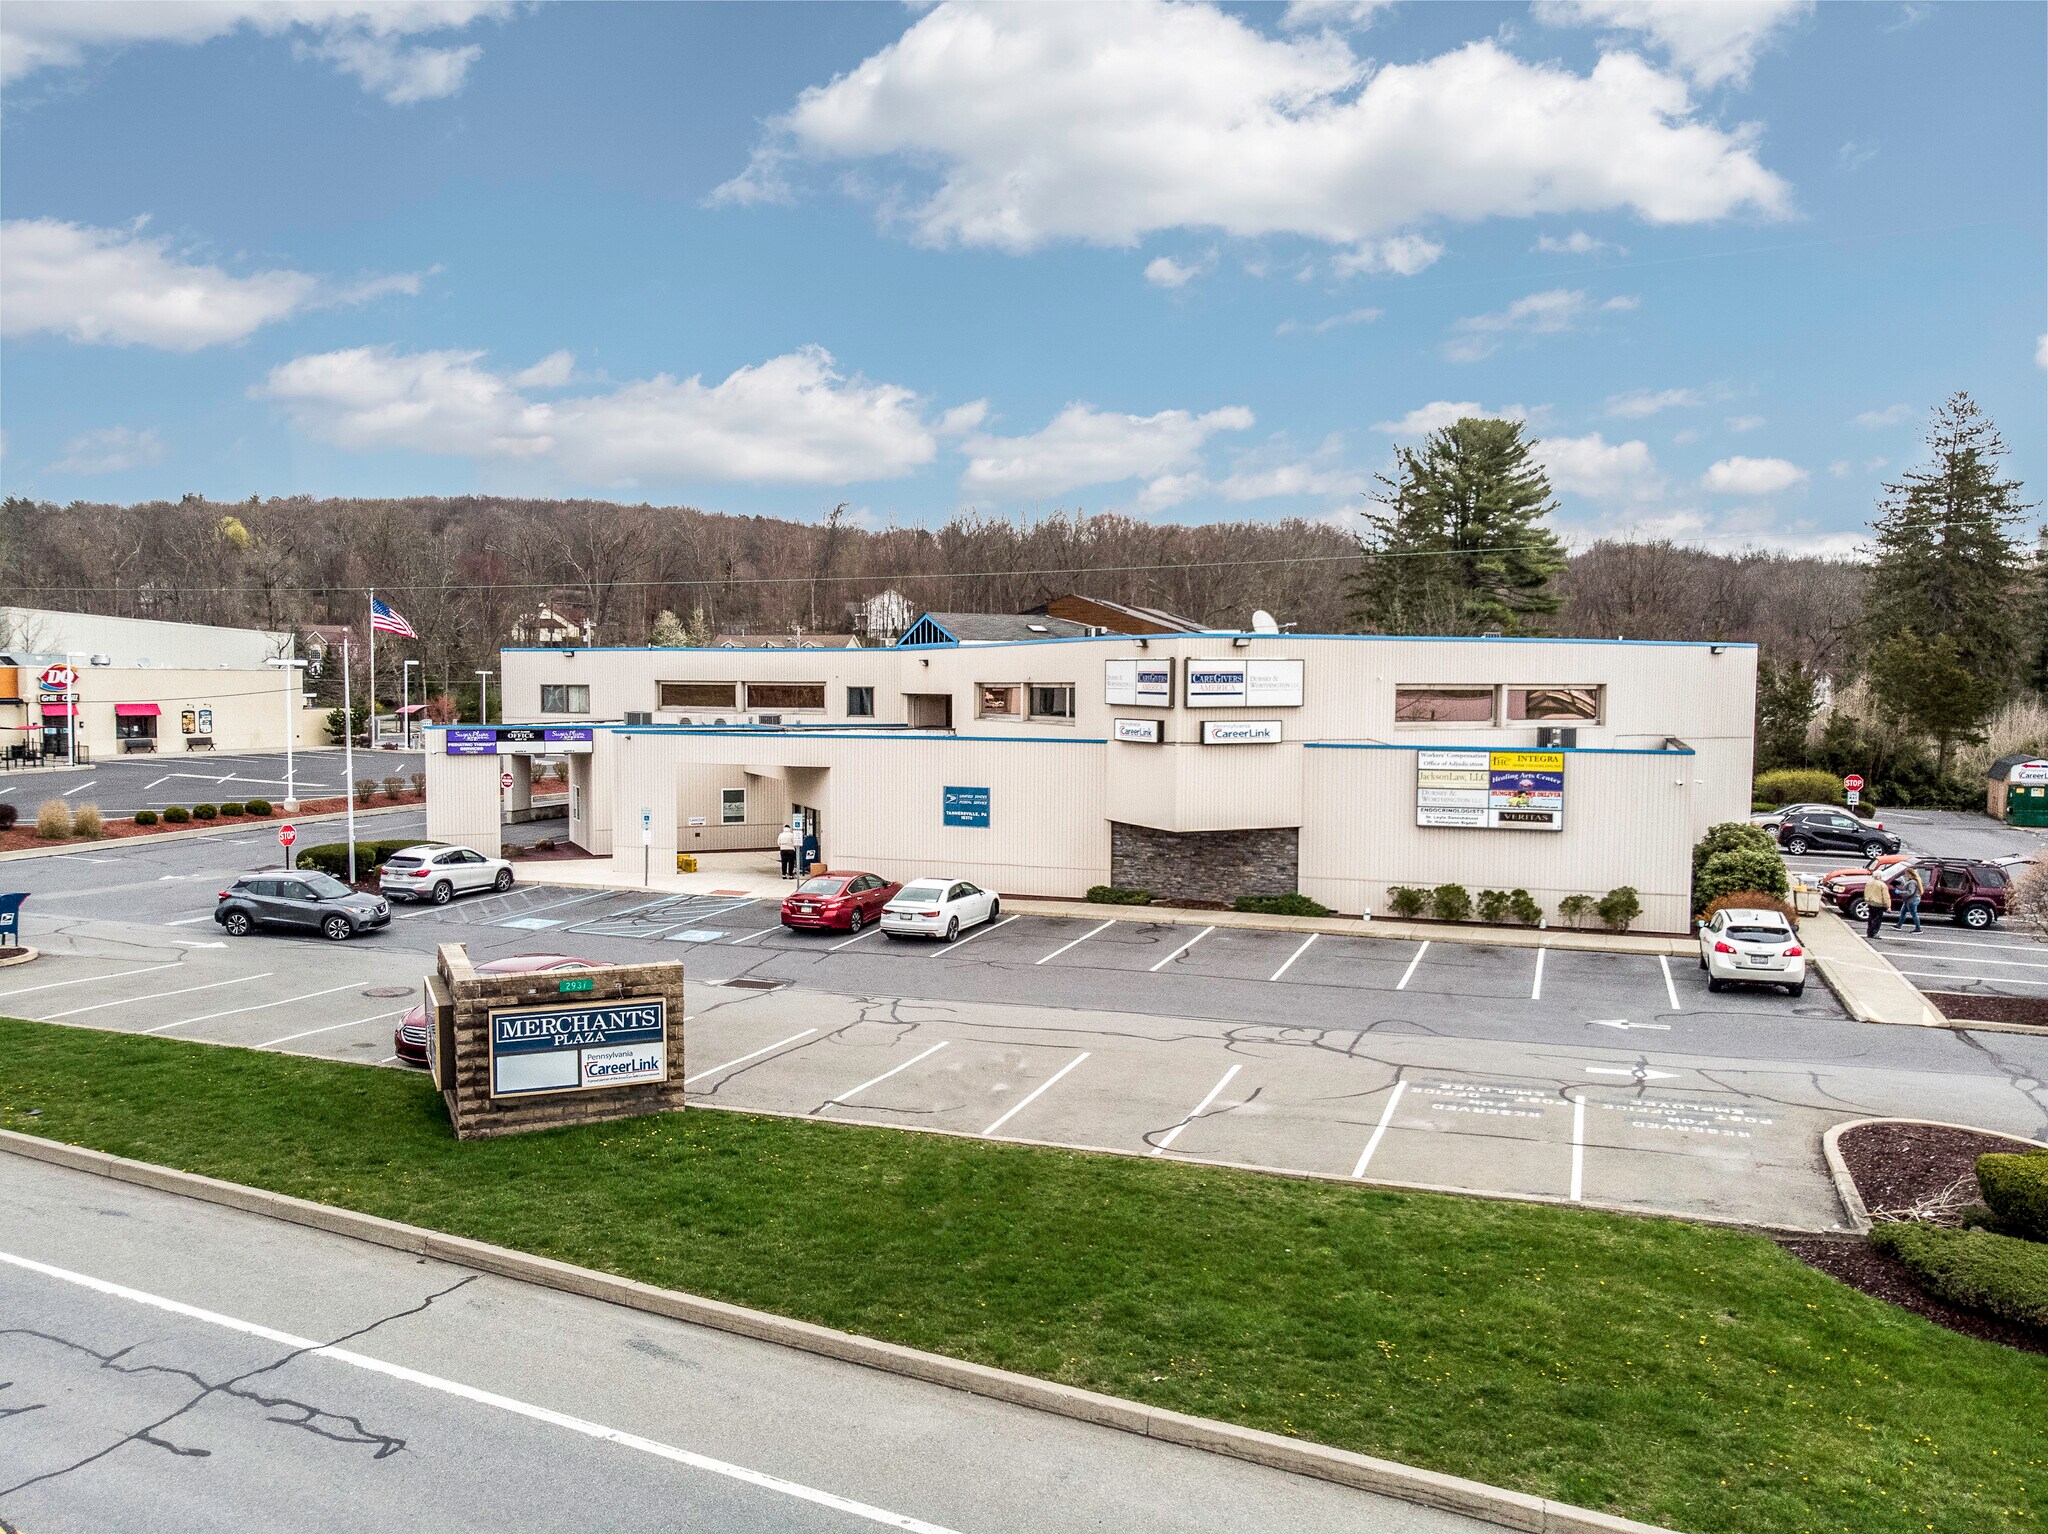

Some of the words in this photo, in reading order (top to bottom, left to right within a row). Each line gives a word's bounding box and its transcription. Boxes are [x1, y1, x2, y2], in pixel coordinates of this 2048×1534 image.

[47, 669, 75, 684] DQ
[1199, 684, 1236, 692] AMERICA
[41, 694, 57, 702] Grill
[1120, 726, 1152, 737] CareerLink
[1215, 727, 1271, 738] CareerLink
[1517, 755, 1559, 763] INTEGRA
[1469, 773, 1488, 781] LLC
[1492, 774, 1519, 783] Healing
[1536, 773, 1562, 785] Center
[1845, 779, 1862, 787] STOP
[1503, 813, 1548, 821] VERITAS
[280, 831, 295, 840] STOP
[502, 1010, 657, 1039] MERCHANTS
[554, 1031, 606, 1046] PLAZA
[587, 1050, 634, 1061] Pennsylvania
[588, 1056, 660, 1076] CareerLink
[1438, 1082, 1546, 1097] EMPLOYEE
[1468, 1099, 1508, 1108] FOR
[1514, 1096, 1569, 1106] POST
[1432, 1103, 1542, 1118] RESERVED
[1630, 1099, 1745, 1115] EMPLOYEE
[1714, 1114, 1773, 1125] POST
[1632, 1121, 1751, 1138] RESERVED
